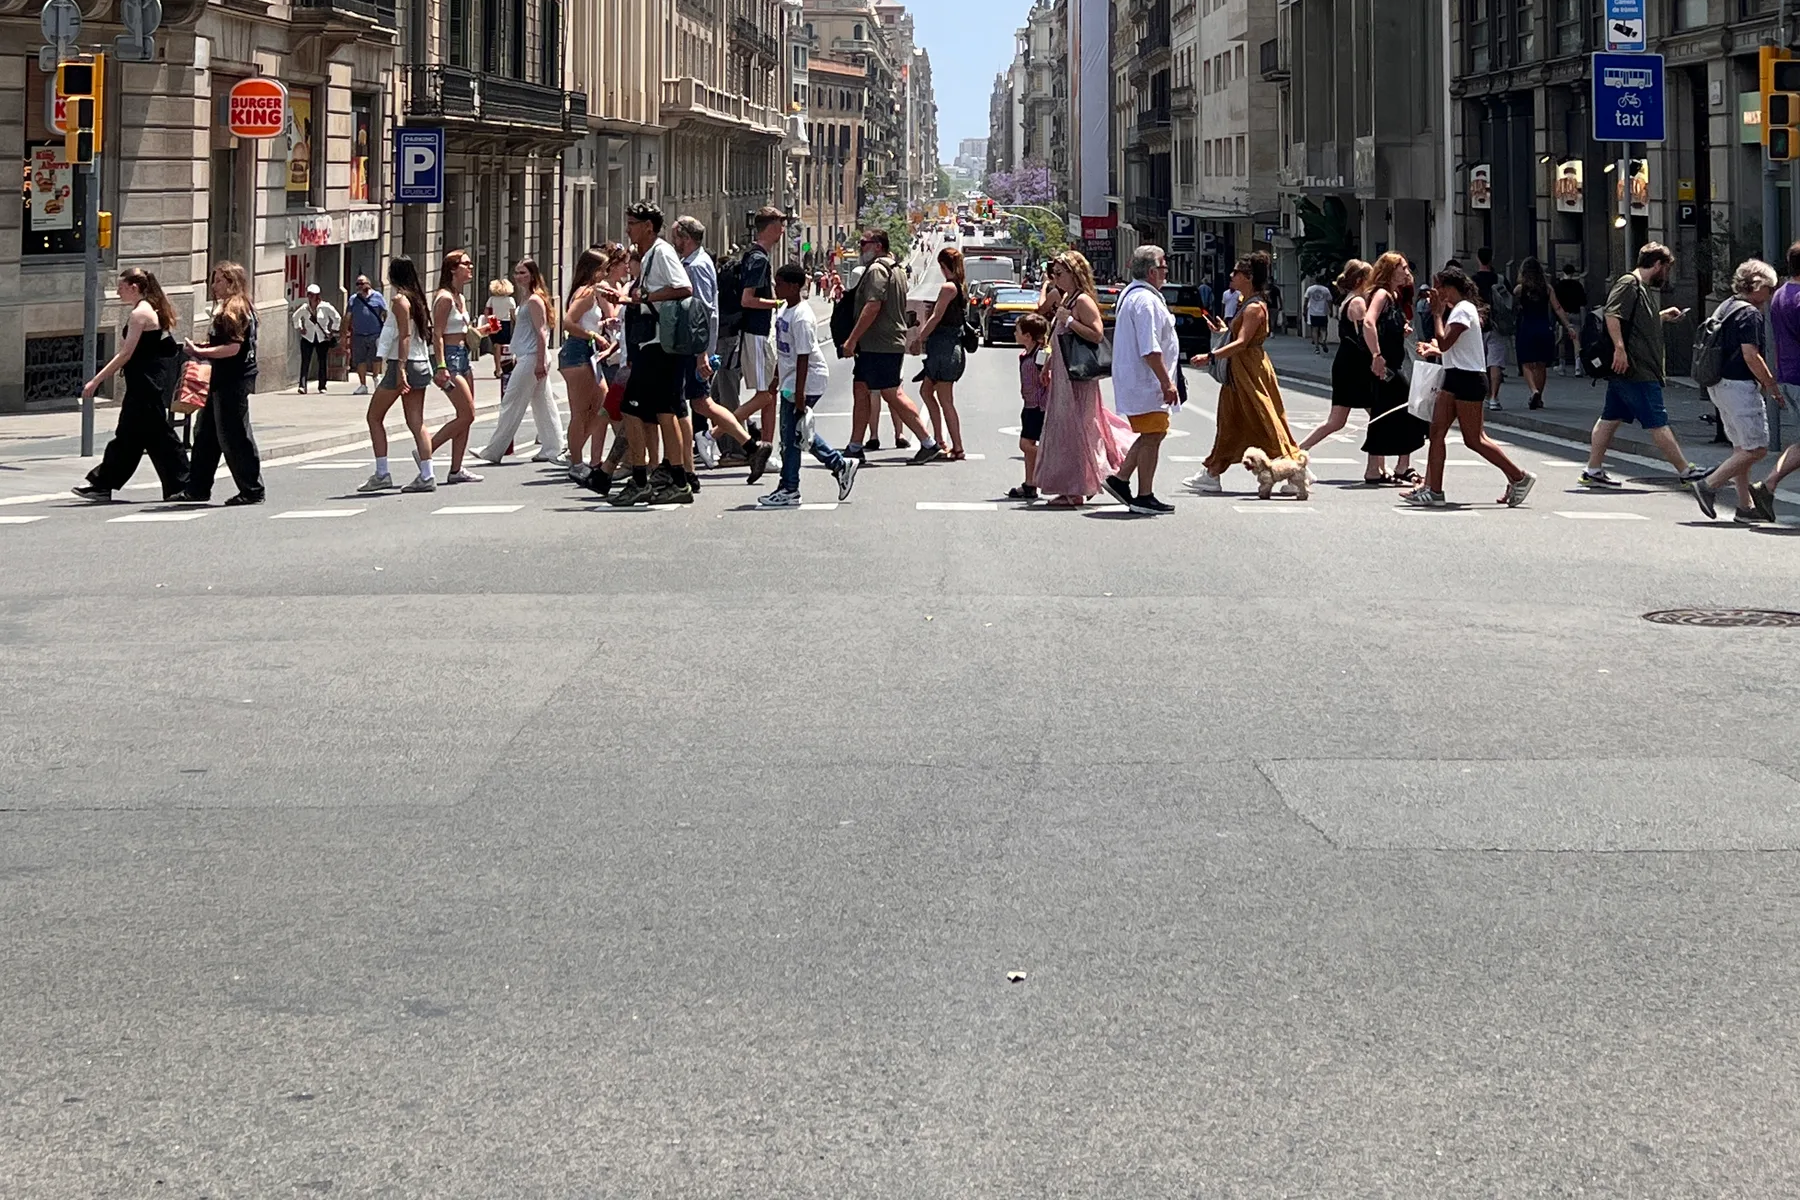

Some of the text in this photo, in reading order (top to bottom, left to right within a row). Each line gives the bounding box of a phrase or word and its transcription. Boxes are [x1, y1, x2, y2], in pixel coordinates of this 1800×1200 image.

[231, 98, 281, 108] BURGER
[231, 109, 281, 125] KING
[1615, 110, 1644, 127] taxi
[404, 146, 435, 185] P
[1304, 175, 1345, 188] Hotel
[1682, 207, 1692, 219] P
[1176, 216, 1191, 233] P
[1203, 232, 1216, 250] P
